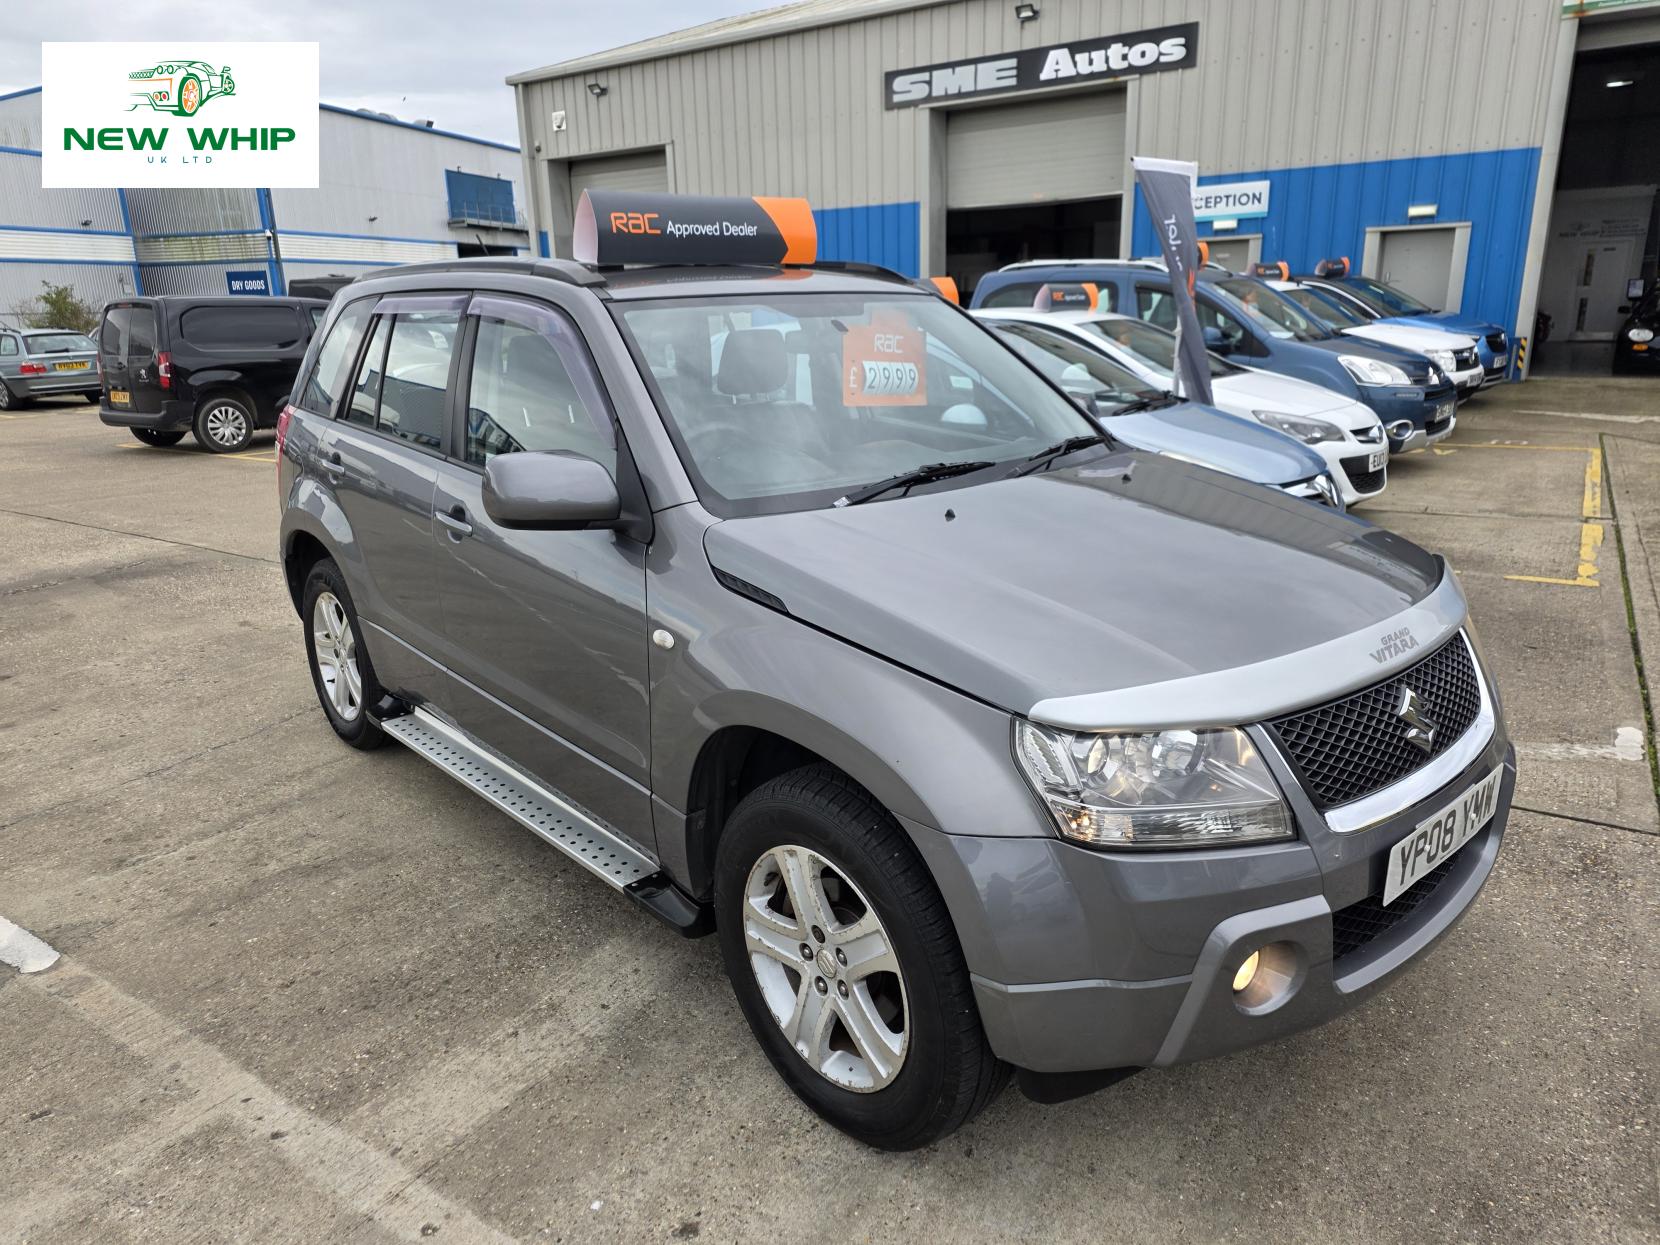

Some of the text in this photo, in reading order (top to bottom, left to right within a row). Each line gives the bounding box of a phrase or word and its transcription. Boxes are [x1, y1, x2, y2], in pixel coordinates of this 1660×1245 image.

[892, 37, 1187, 103] SME Autos
[1194, 191, 1262, 210] CEPTION
[666, 220, 720, 239] Approved
[722, 221, 758, 237] Dealer
[231, 279, 266, 291] DRY GOODS
[866, 366, 917, 390] 2999
[1380, 626, 1411, 646] GRAND
[1369, 634, 1420, 664] VITARA
[1399, 774, 1497, 887] YP08 YMW
